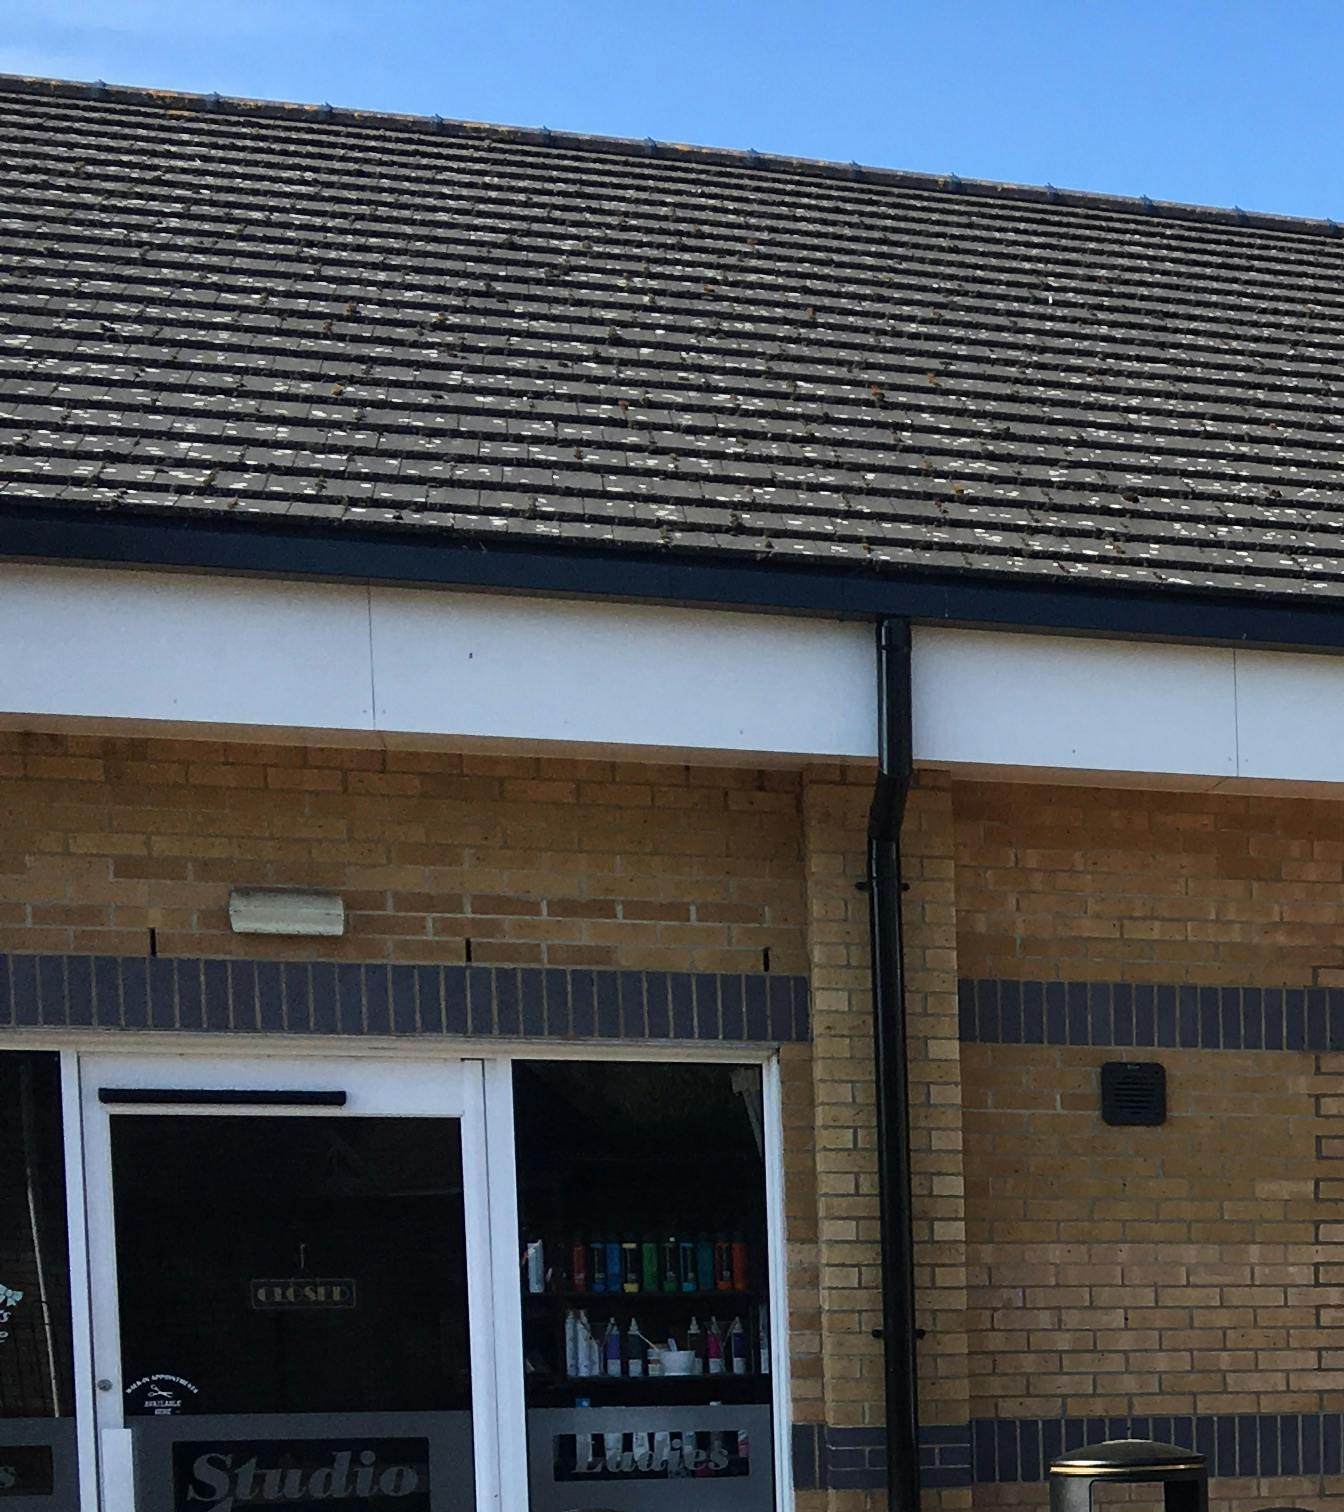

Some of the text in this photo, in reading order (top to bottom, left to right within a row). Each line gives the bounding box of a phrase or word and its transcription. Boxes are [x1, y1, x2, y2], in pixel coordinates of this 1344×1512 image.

[257, 1286, 350, 1302] CLOSED
[572, 1436, 729, 1474] Ladies
[186, 1449, 420, 1502] Studio
